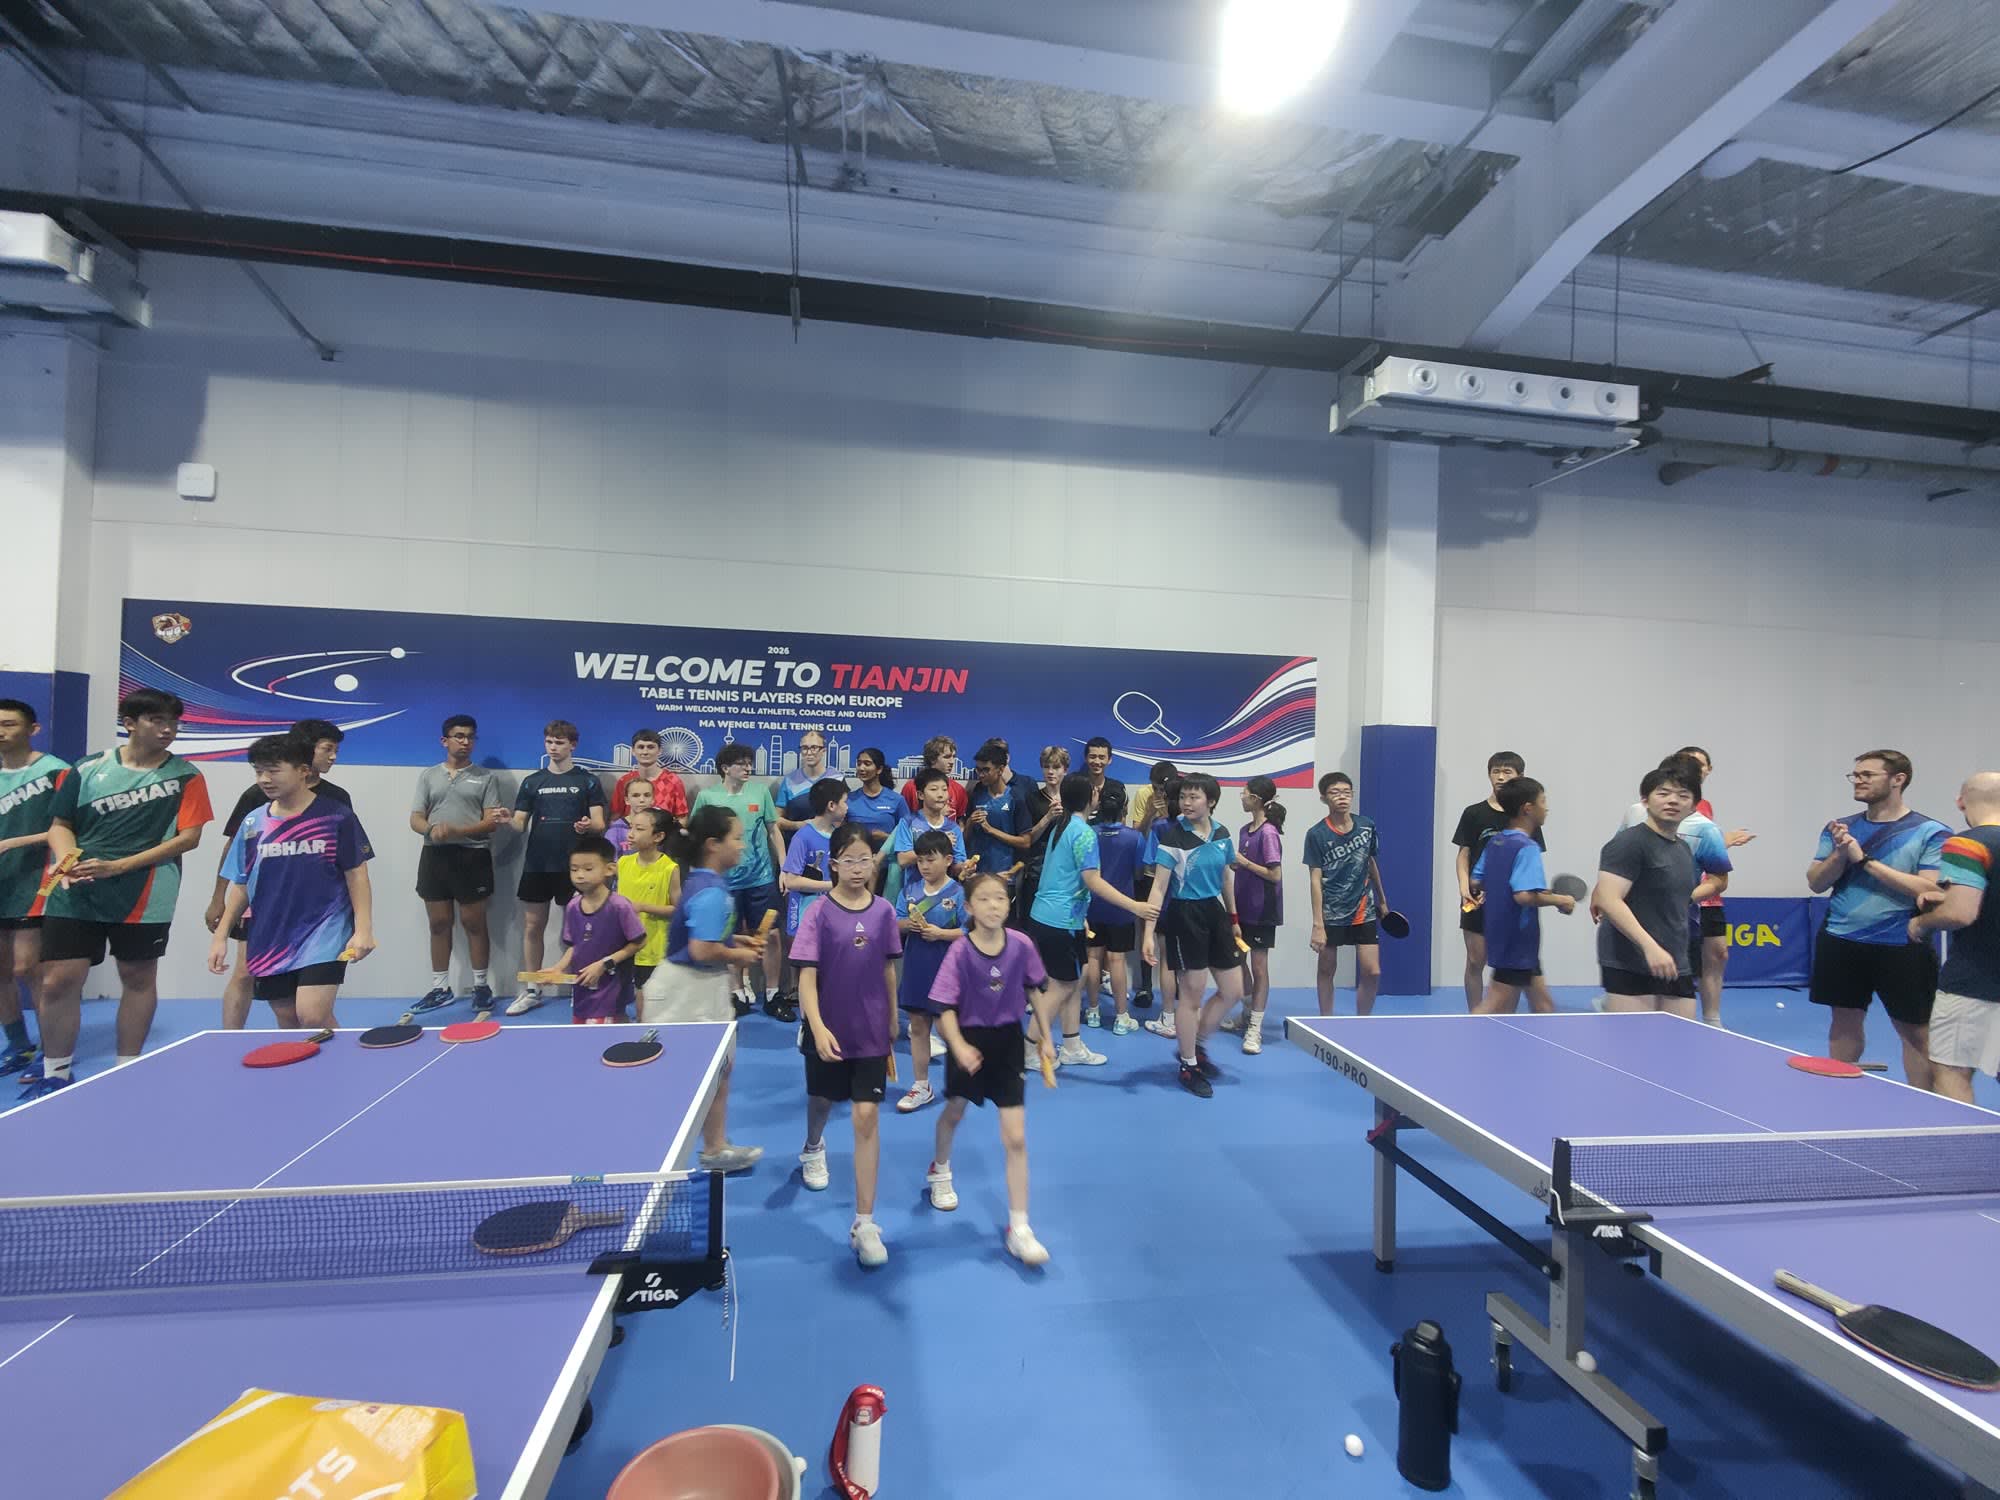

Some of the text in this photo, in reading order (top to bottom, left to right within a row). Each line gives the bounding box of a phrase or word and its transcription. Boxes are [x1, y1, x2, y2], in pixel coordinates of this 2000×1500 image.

[767, 646, 790, 655] 2026
[574, 651, 969, 694] WELCOME TO TIANJIN
[639, 686, 903, 708] TABLE TENNIS PLAYERS FROM EUROPE
[656, 703, 887, 719] WARM WELCOME TO ALL ATHLETES, COACHES AND GUESTS
[699, 719, 852, 732] MA WENGE TABLE TENNIS CLUB
[0, 775, 54, 815] IBHAR
[91, 779, 181, 815] TIBHAR
[1725, 923, 1782, 947] IGA
[1313, 1043, 1368, 1089] 7190-PRO
[1592, 1224, 1624, 1238] STIGA
[626, 1289, 679, 1303] STIGA
